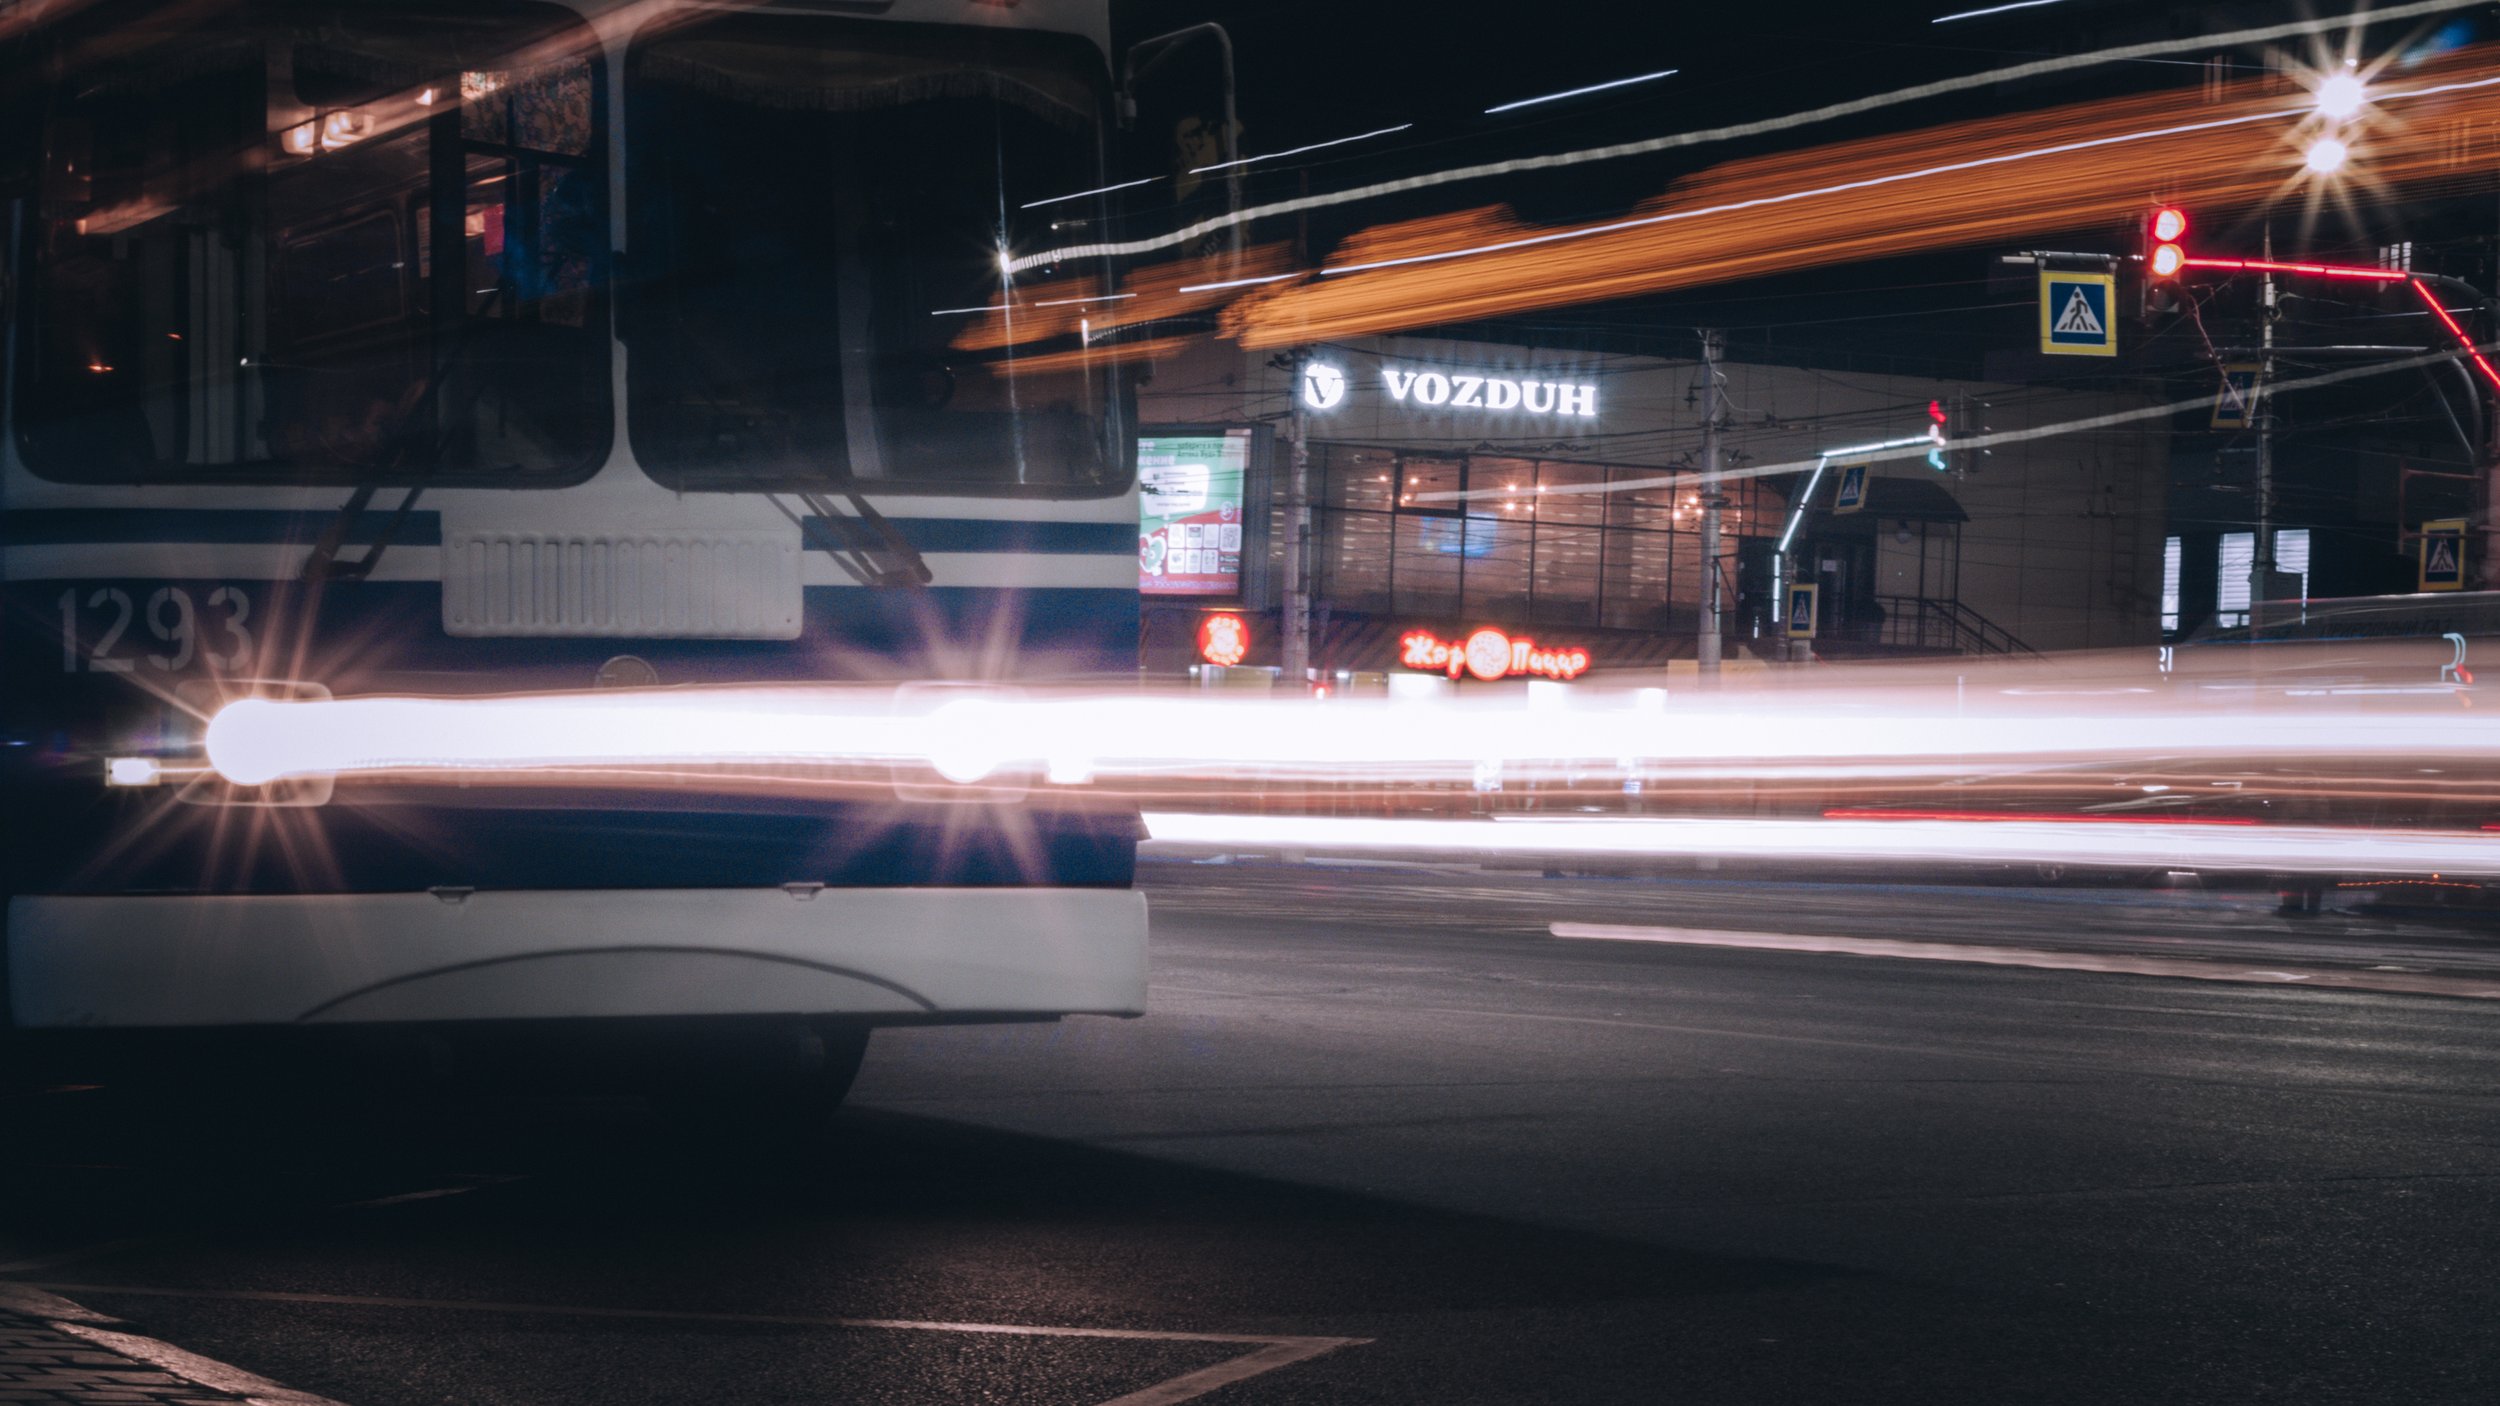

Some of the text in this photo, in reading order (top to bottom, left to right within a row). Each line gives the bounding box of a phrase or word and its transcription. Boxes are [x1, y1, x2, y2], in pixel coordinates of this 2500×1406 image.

[1383, 369, 1597, 416] VOZDUH
[58, 586, 253, 673] 1293
[1402, 634, 1588, 676] Жар Пицца
